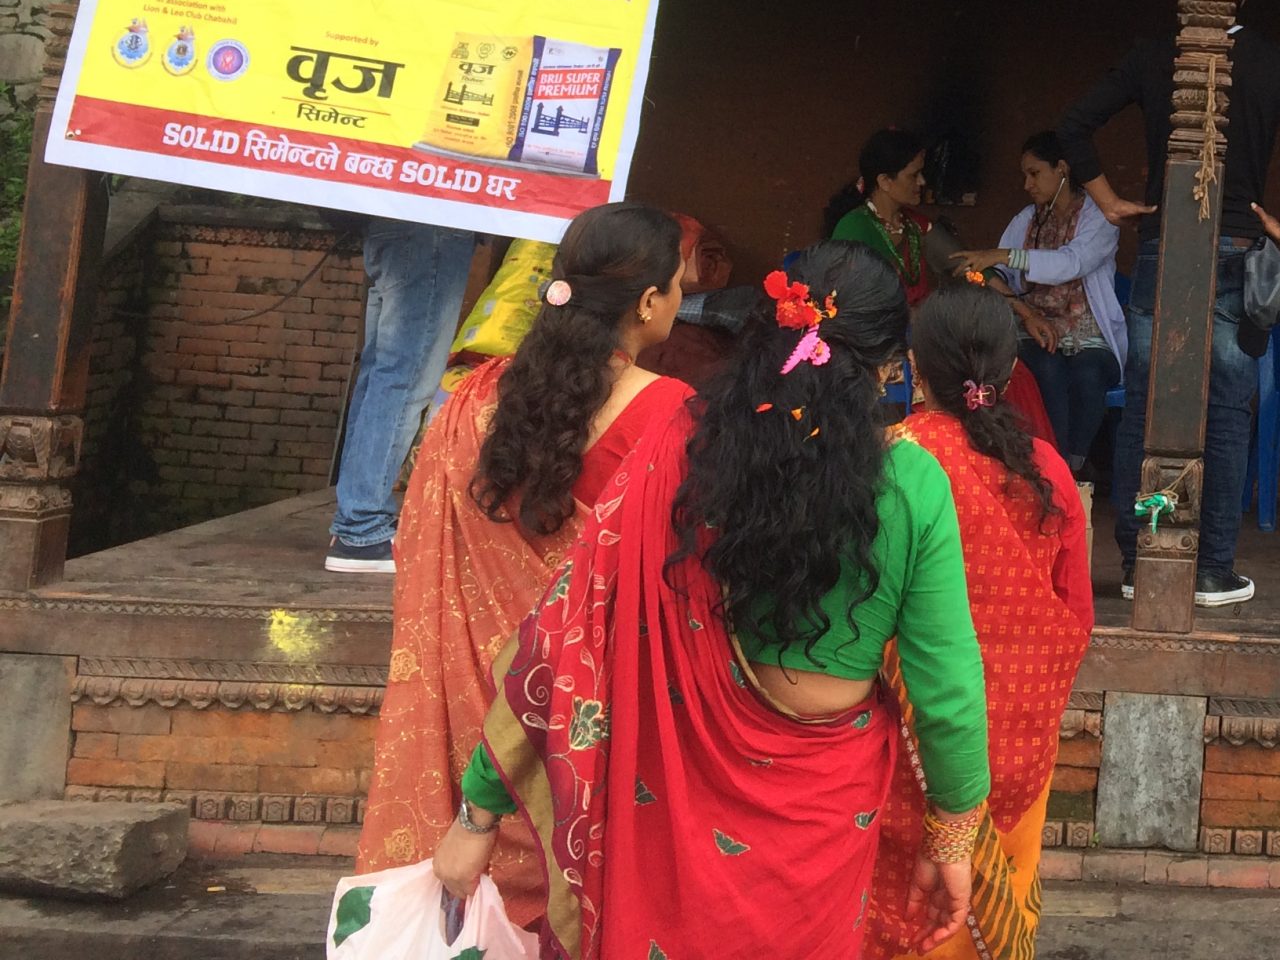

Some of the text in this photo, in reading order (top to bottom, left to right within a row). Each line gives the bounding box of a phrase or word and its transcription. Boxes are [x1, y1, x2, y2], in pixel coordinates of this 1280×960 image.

[143, 4, 160, 14] Lion
[170, 9, 184, 17] Leo
[186, 10, 202, 20] Club
[209, 4, 226, 12] with
[325, 31, 379, 47] Supported by
[286, 45, 405, 101] वृज
[566, 72, 600, 84] SUPER
[537, 83, 599, 97] PREMIUM
[297, 103, 368, 128] सिमेन्ट
[162, 122, 521, 201] SOLID सिमेन्टले बन्छ SOLID घर
